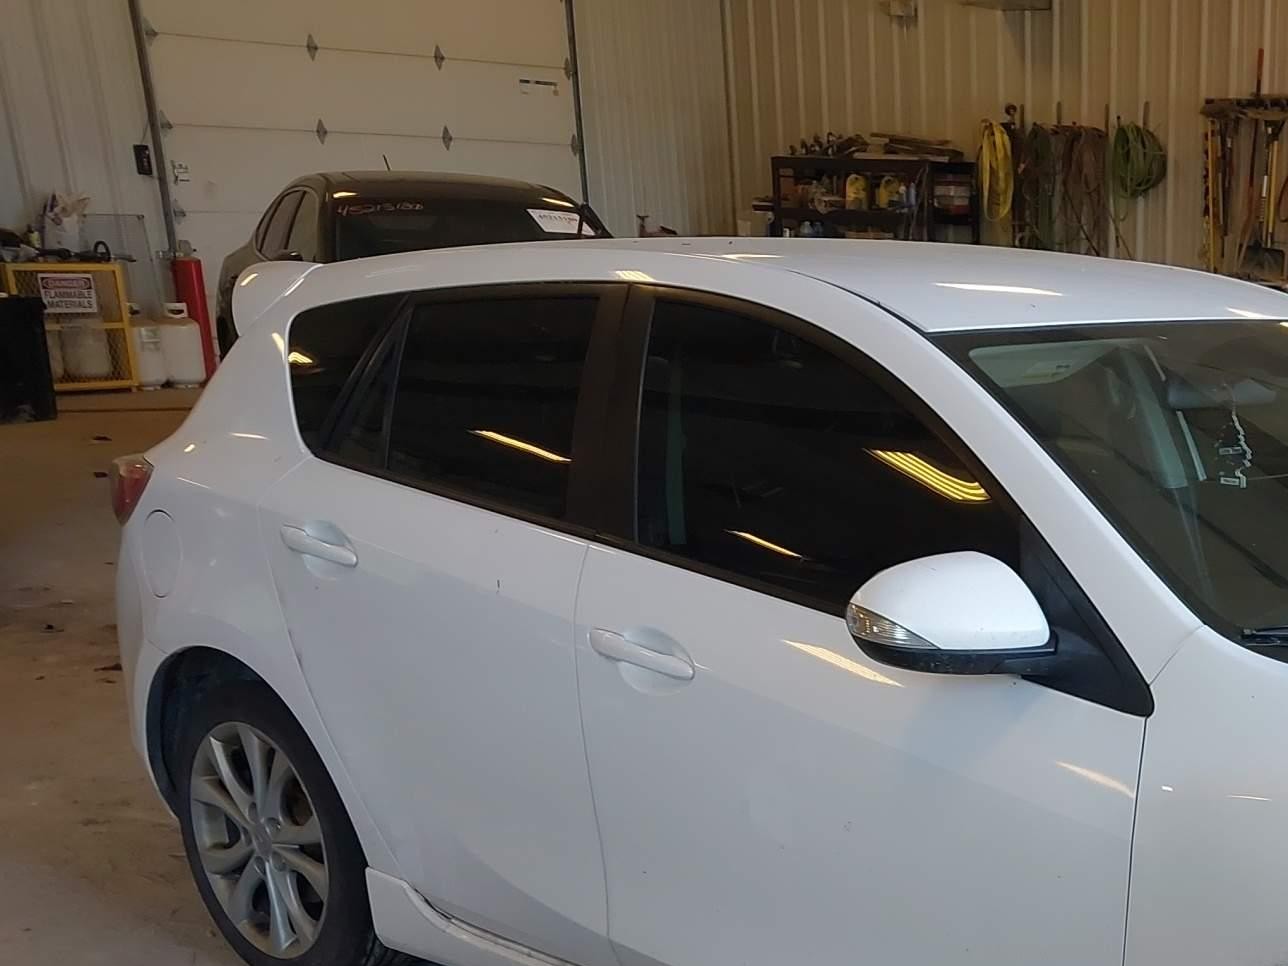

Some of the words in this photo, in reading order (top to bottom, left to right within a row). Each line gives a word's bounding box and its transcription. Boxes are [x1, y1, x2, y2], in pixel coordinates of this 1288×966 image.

[46, 278, 87, 289] DANGER
[44, 290, 93, 299] FLAMMABLE
[46, 299, 93, 309] MATERIALS
